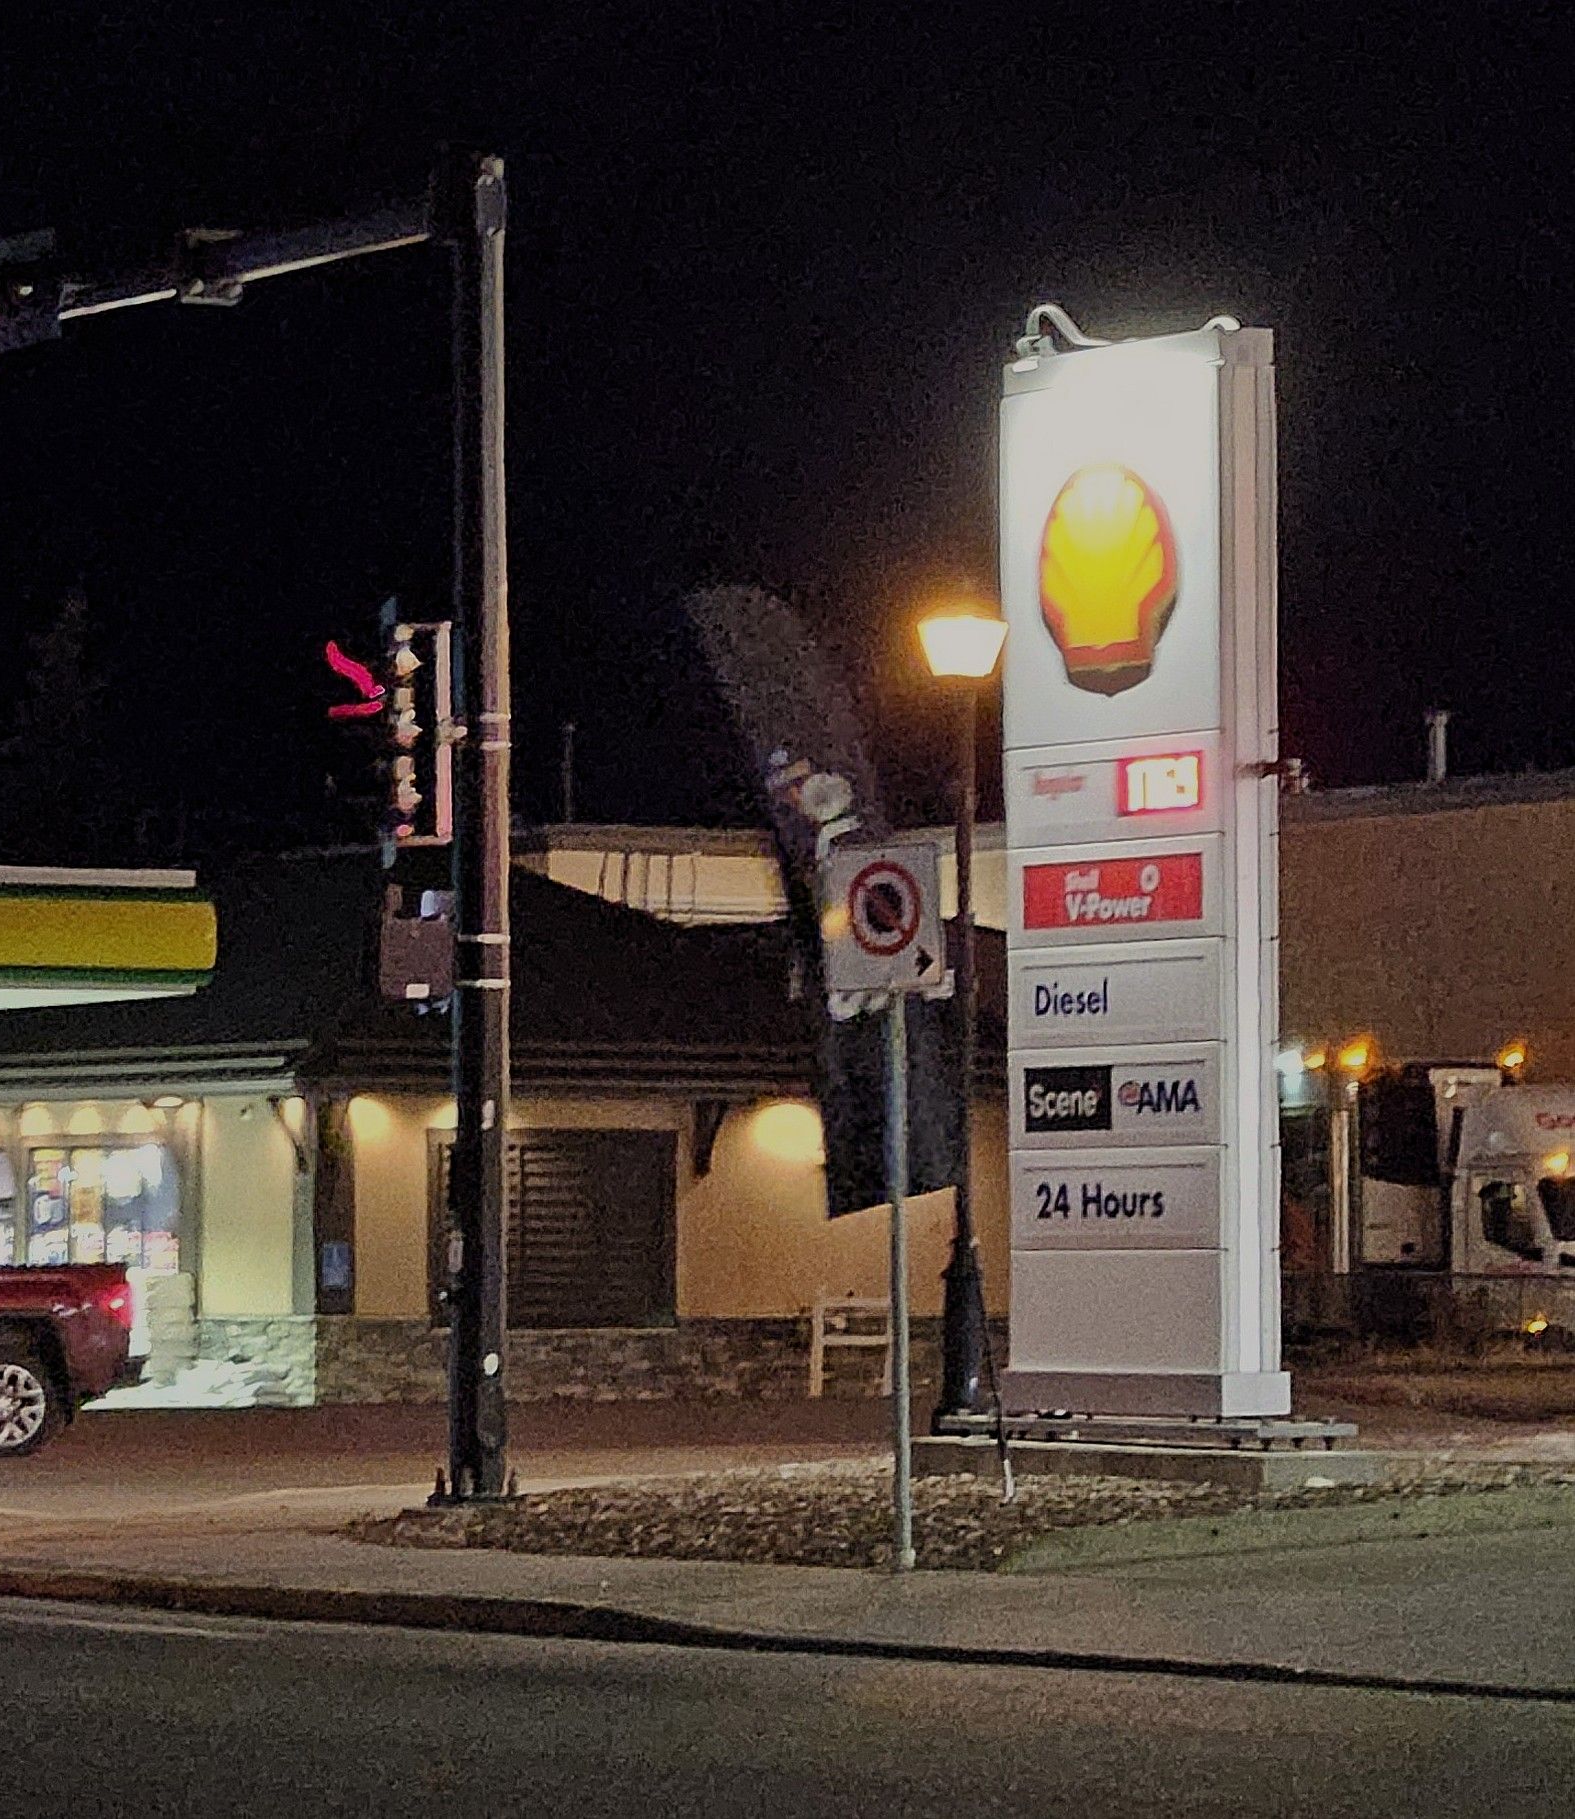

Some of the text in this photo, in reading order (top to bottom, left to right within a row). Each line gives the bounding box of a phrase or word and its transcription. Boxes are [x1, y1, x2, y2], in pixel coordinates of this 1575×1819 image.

[1065, 891, 1153, 921] V-Power
[1034, 977, 1109, 1017] Diesel
[1028, 1082, 1099, 1120] Scene
[1136, 1078, 1202, 1115] AMA
[1036, 1181, 1165, 1220] 24 Hours
